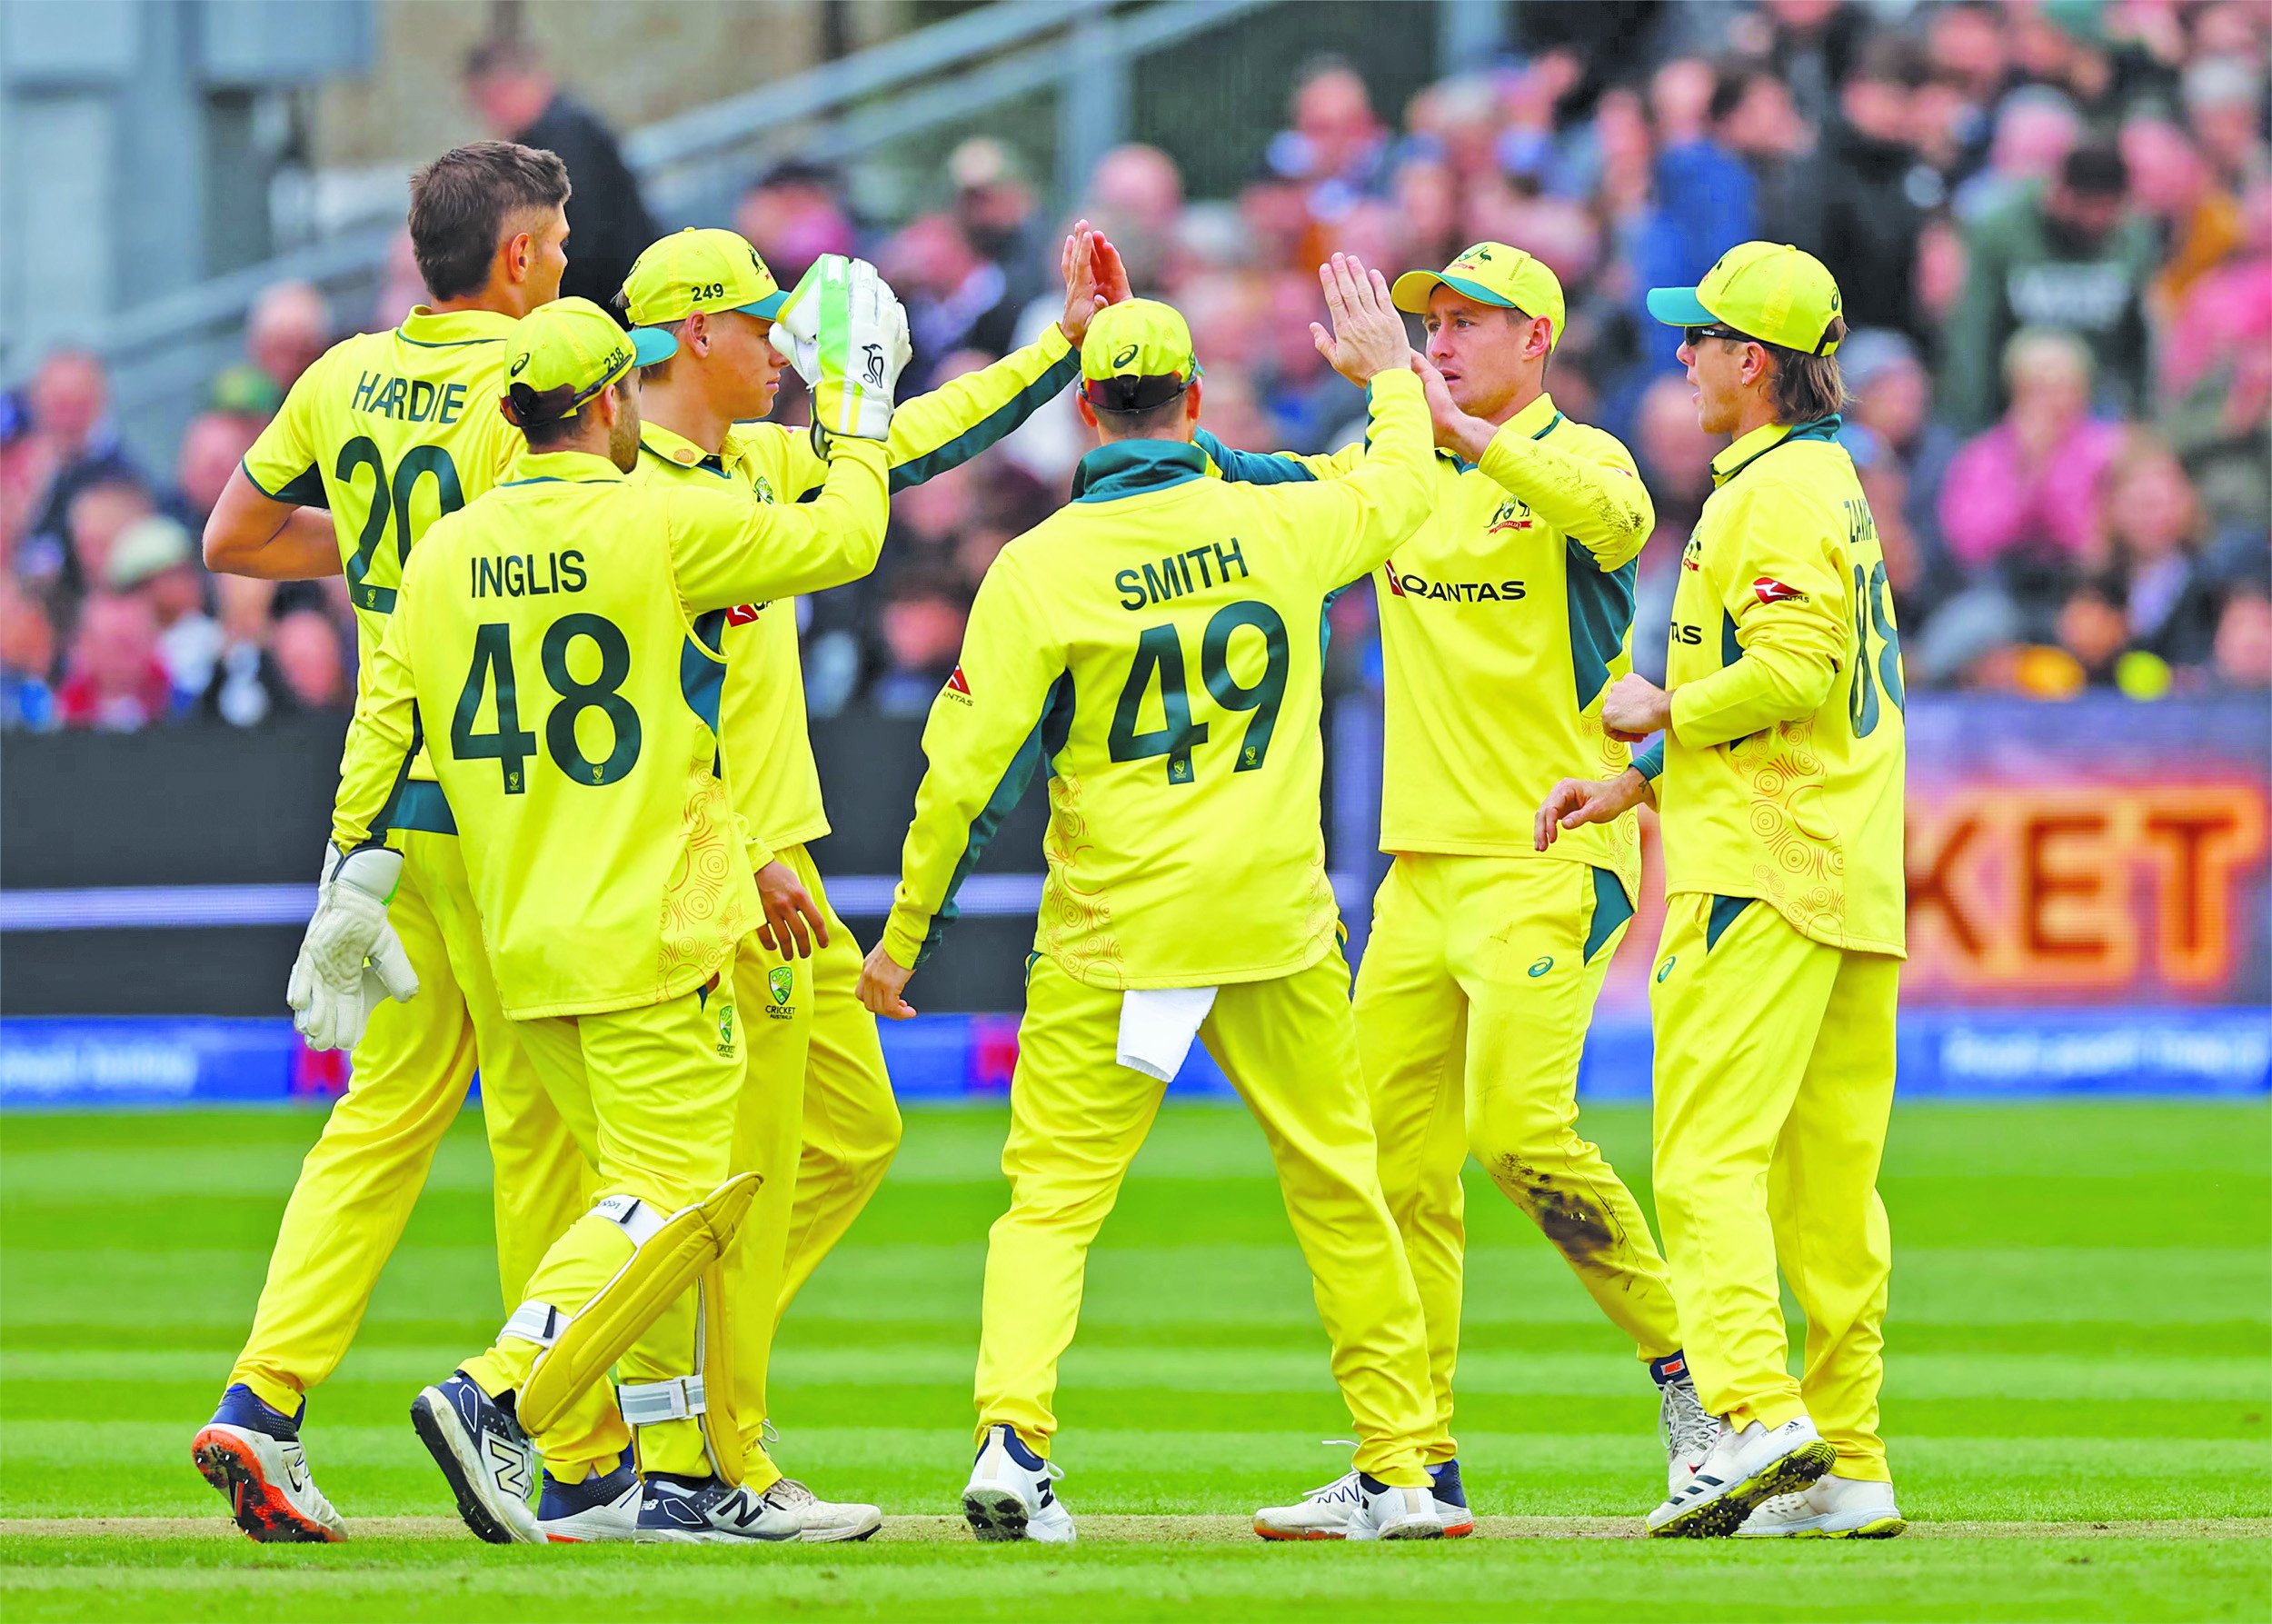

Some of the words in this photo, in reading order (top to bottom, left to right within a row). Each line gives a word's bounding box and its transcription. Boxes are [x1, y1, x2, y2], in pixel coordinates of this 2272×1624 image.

[692, 284, 724, 302] 249
[604, 347, 624, 374] 238
[352, 371, 467, 423] HARDIE
[335, 436, 465, 614] 20
[472, 550, 587, 598] INGLIS
[1115, 538, 1249, 611] SMITH
[1401, 574, 1527, 603] QANTAS
[450, 613, 642, 794] 48
[1108, 601, 1290, 785] 49
[765, 1005, 795, 1015] CRICKET
